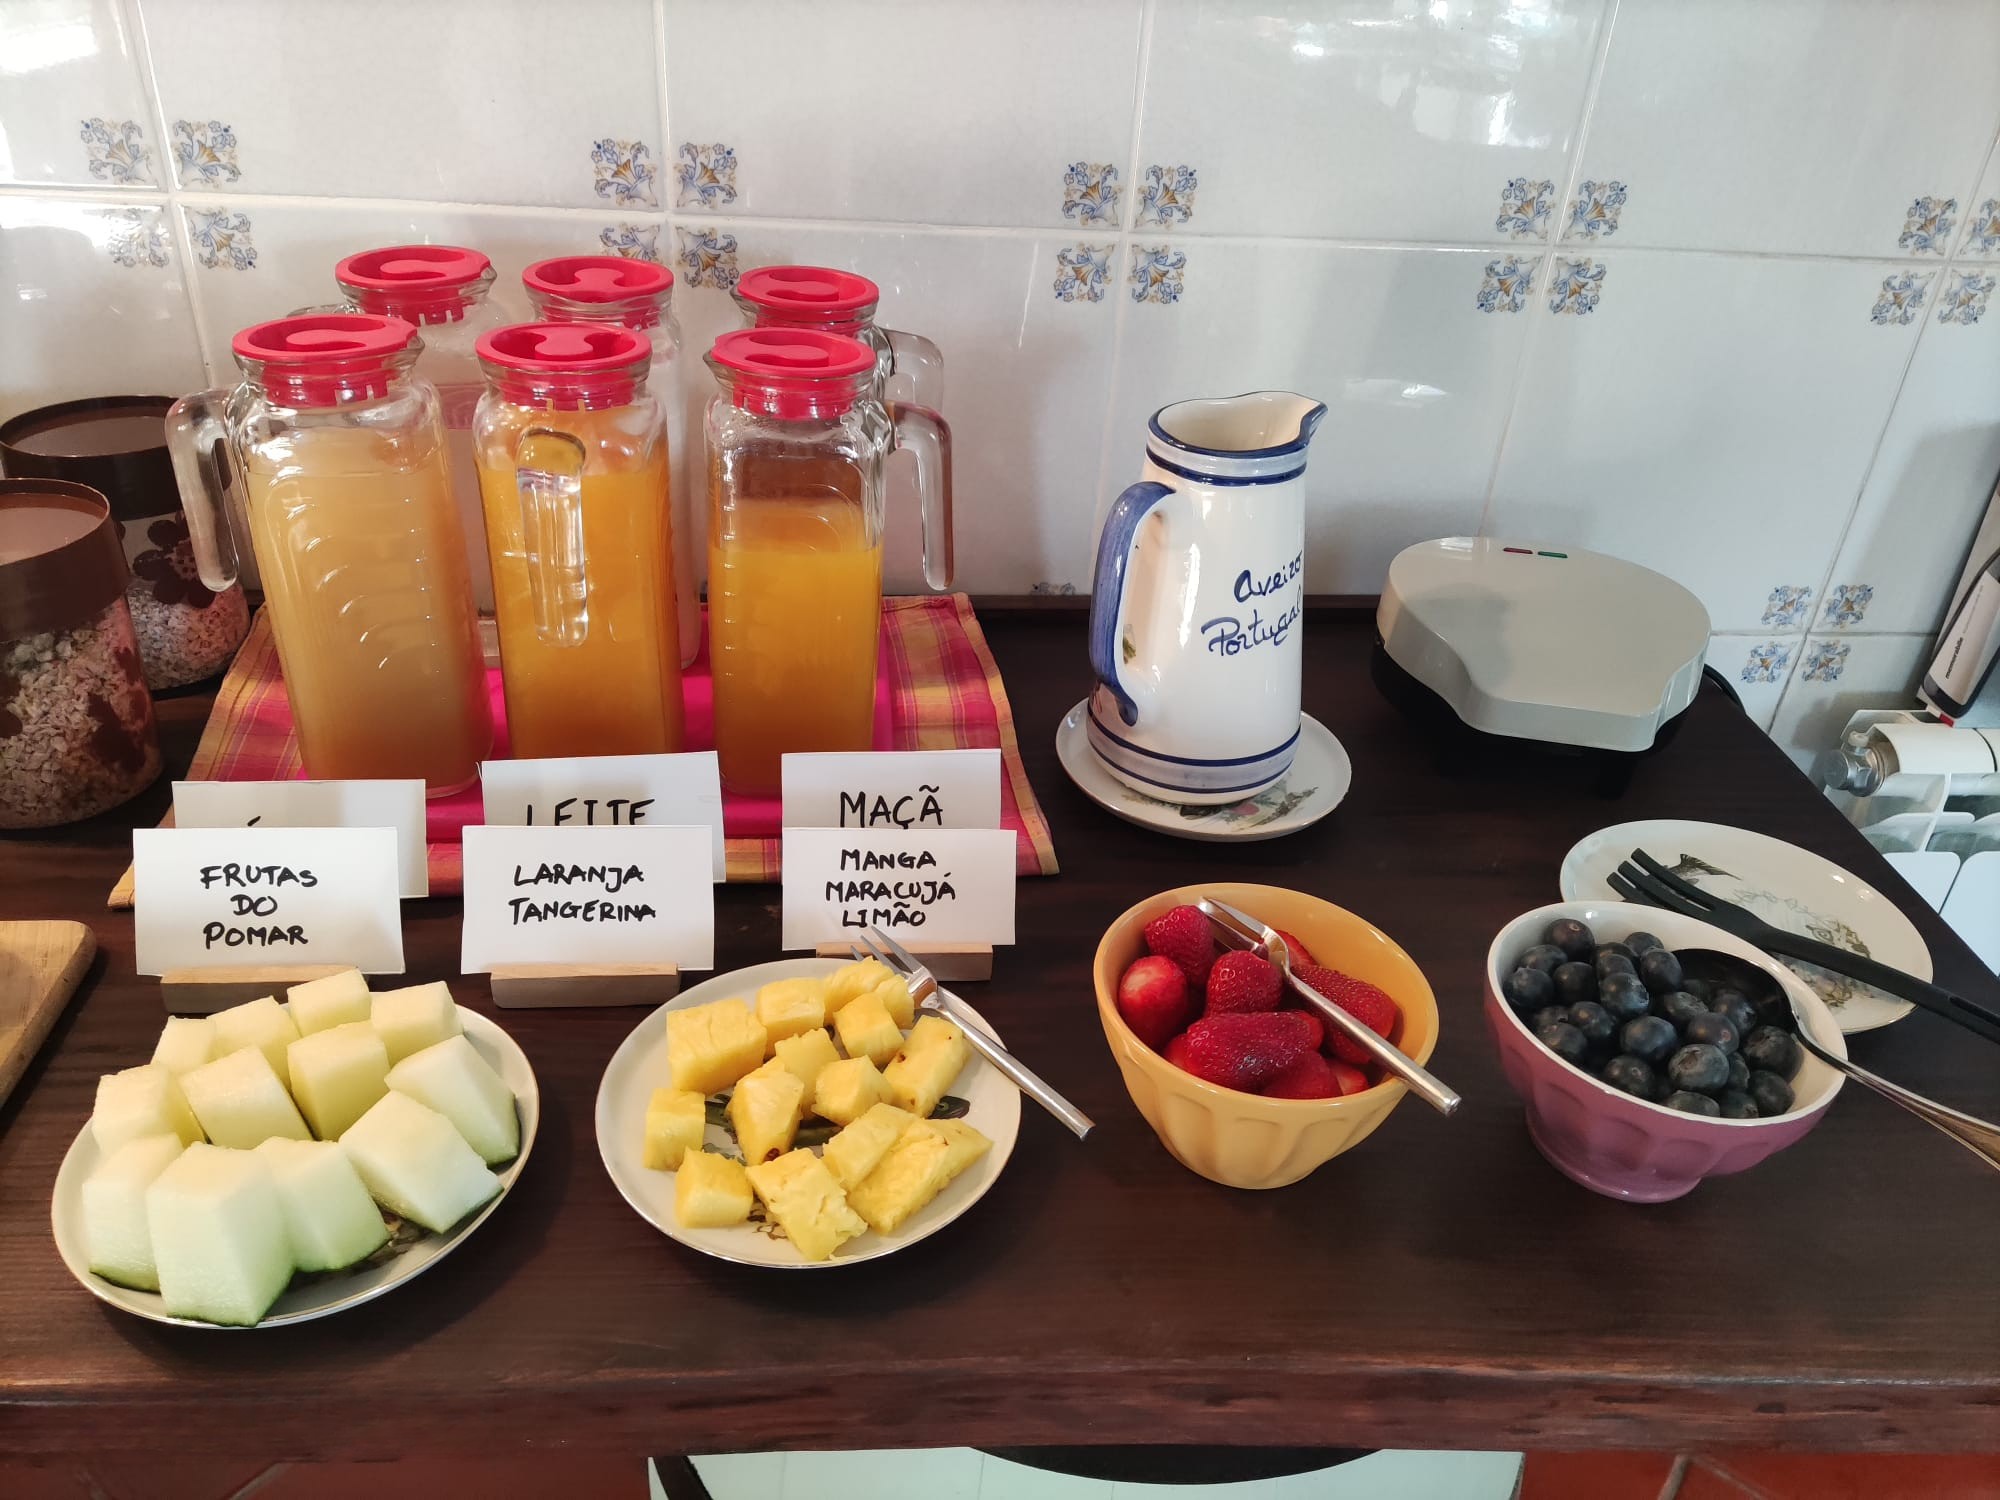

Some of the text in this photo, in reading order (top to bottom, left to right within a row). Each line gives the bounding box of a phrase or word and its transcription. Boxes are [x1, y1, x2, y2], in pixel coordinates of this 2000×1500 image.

[1200, 584, 1302, 656] Portugal
[840, 784, 943, 829] MAÇÃ
[840, 849, 936, 871] MANGA
[199, 863, 318, 889] FRUTAS
[514, 863, 644, 893] LARANJA
[825, 872, 955, 904] MARACUJÁ
[230, 894, 278, 916] DO
[508, 897, 656, 925] TANGERINA
[842, 902, 926, 927] LIMÃO
[203, 921, 308, 949] POMAR
